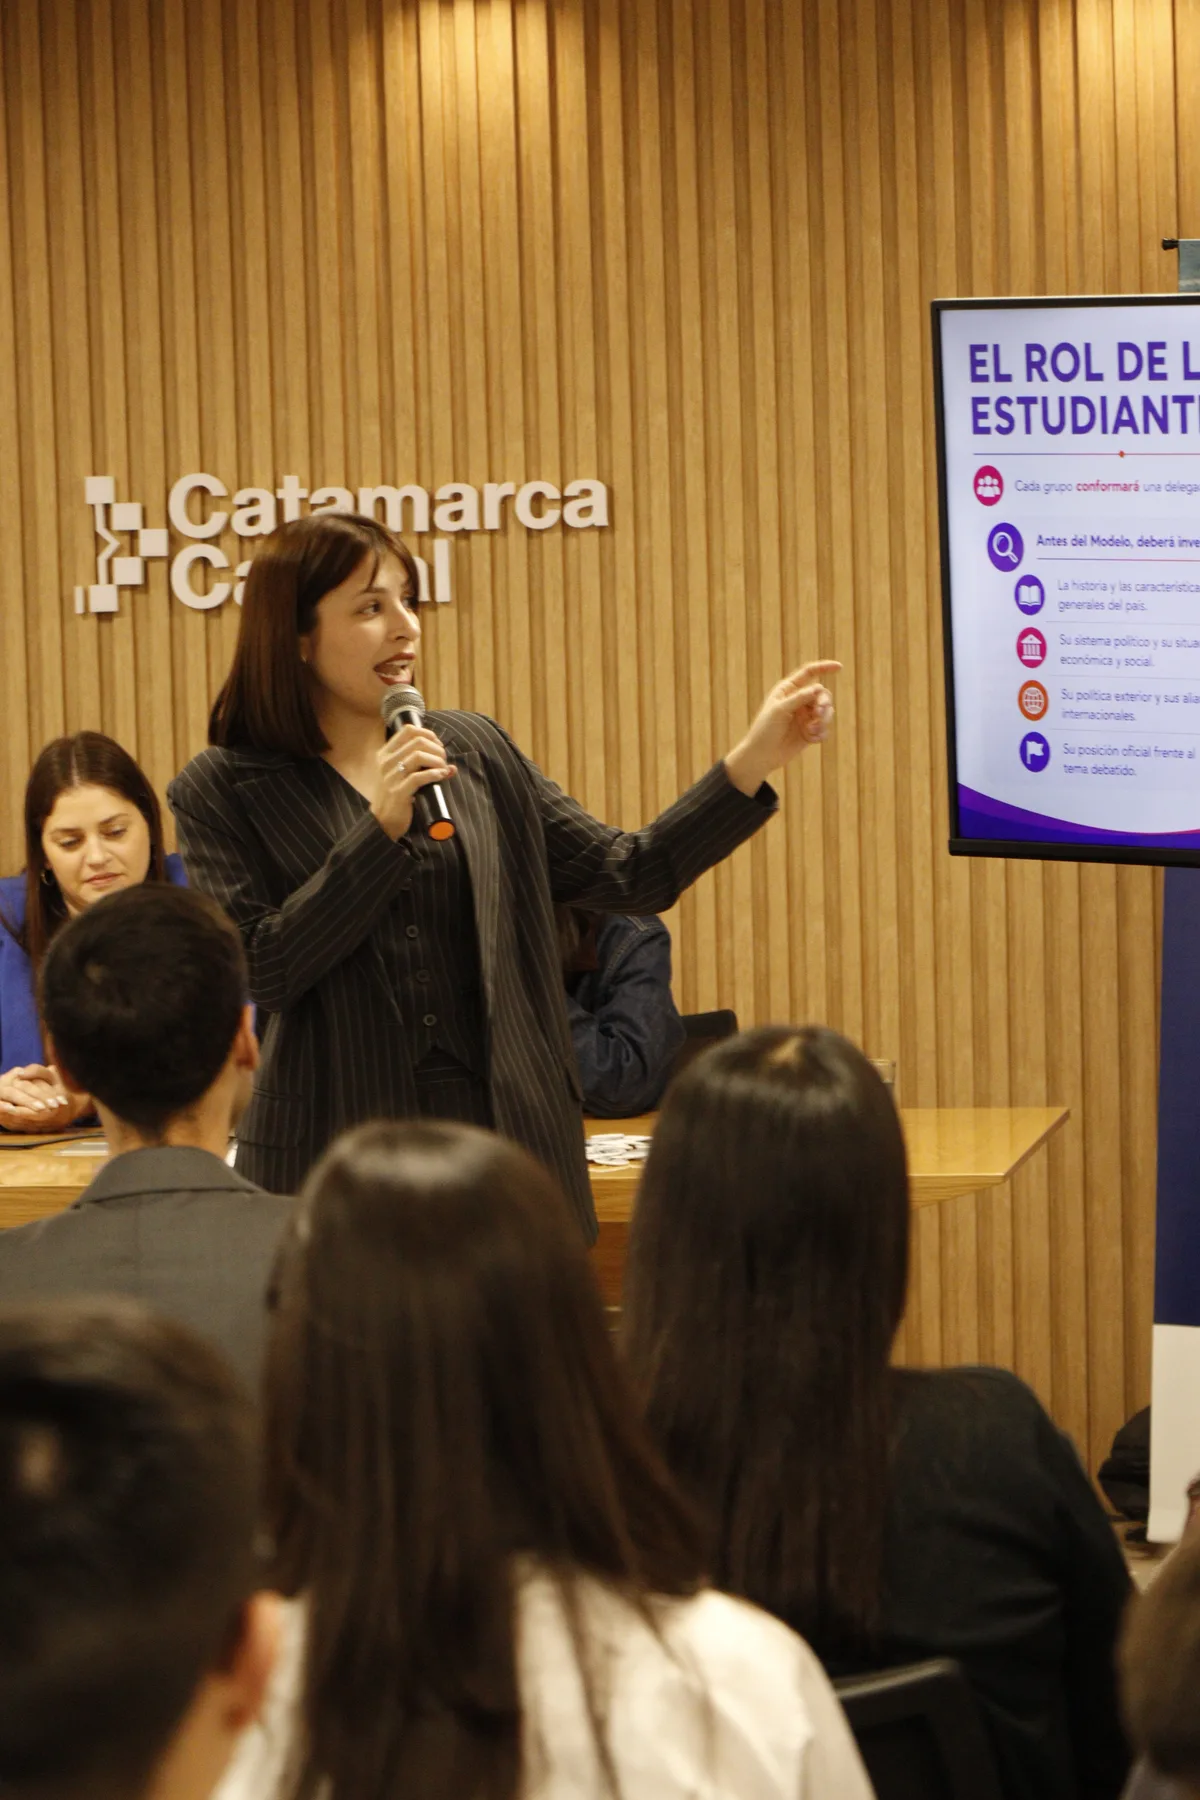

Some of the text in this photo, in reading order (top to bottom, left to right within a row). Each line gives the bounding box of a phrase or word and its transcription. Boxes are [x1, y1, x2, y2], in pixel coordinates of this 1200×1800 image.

[969, 344, 1012, 383] EL
[1025, 342, 1104, 382] ROL
[1118, 341, 1168, 381] DE
[1014, 479, 1041, 493] Cada
[1043, 483, 1073, 496] grupo
[1075, 478, 1140, 493] conformará
[1143, 483, 1163, 493] una
[168, 472, 610, 539] Catamarca
[1036, 534, 1068, 547] Antes
[1070, 534, 1088, 547] del
[1090, 534, 1134, 549] Modelo,
[1136, 534, 1176, 548] deberá
[1057, 579, 1070, 591] La
[1071, 579, 1108, 592] historia
[1110, 583, 1116, 595] y
[1119, 580, 1132, 592] las
[1058, 598, 1148, 613] generales del país.
[1059, 634, 1073, 646] Su
[1074, 634, 1112, 647] sistema
[1113, 635, 1151, 650] político
[1152, 639, 1159, 651] y
[1161, 639, 1173, 648] su
[1060, 654, 1155, 669] económica y social.
[1060, 688, 1074, 701] Su
[1075, 689, 1113, 703] política
[1114, 690, 1152, 703] exterior
[1155, 693, 1161, 706] y
[1163, 694, 1180, 703] sus
[1061, 708, 1137, 722] internacionales.
[1062, 743, 1197, 760] Su posición oficial frente al
[1063, 763, 1137, 777] tema debatido.
